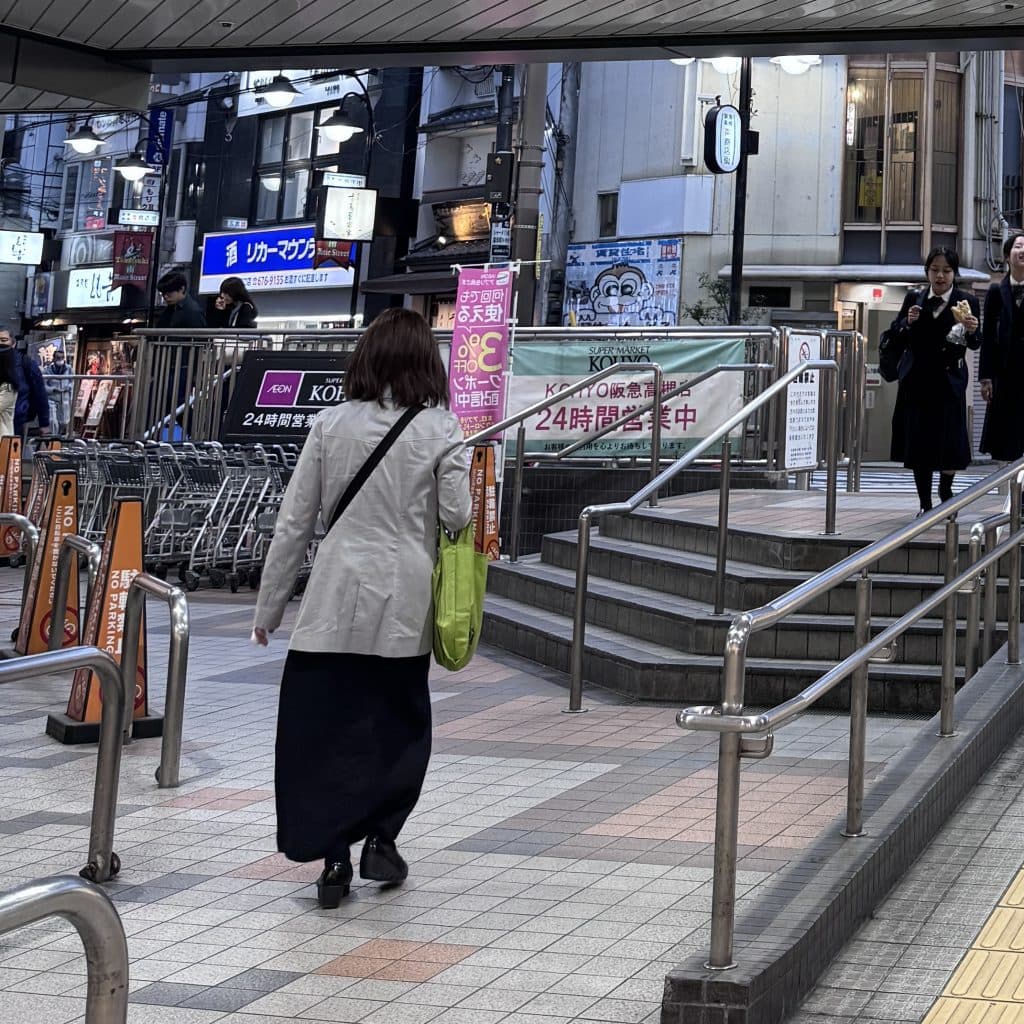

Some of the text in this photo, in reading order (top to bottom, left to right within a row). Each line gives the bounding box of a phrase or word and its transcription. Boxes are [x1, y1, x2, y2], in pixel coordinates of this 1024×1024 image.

[226, 237, 315, 268] 酒 リカーマウンテ
[589, 345, 650, 355] SUPER MARKET
[309, 385, 347, 402] KOH
[242, 412, 318, 428] 24時間営業
[535, 404, 698, 432] 24時間営業中
[475, 469, 484, 485] NO
[63, 505, 75, 527] NO
[111, 570, 120, 590] NO
